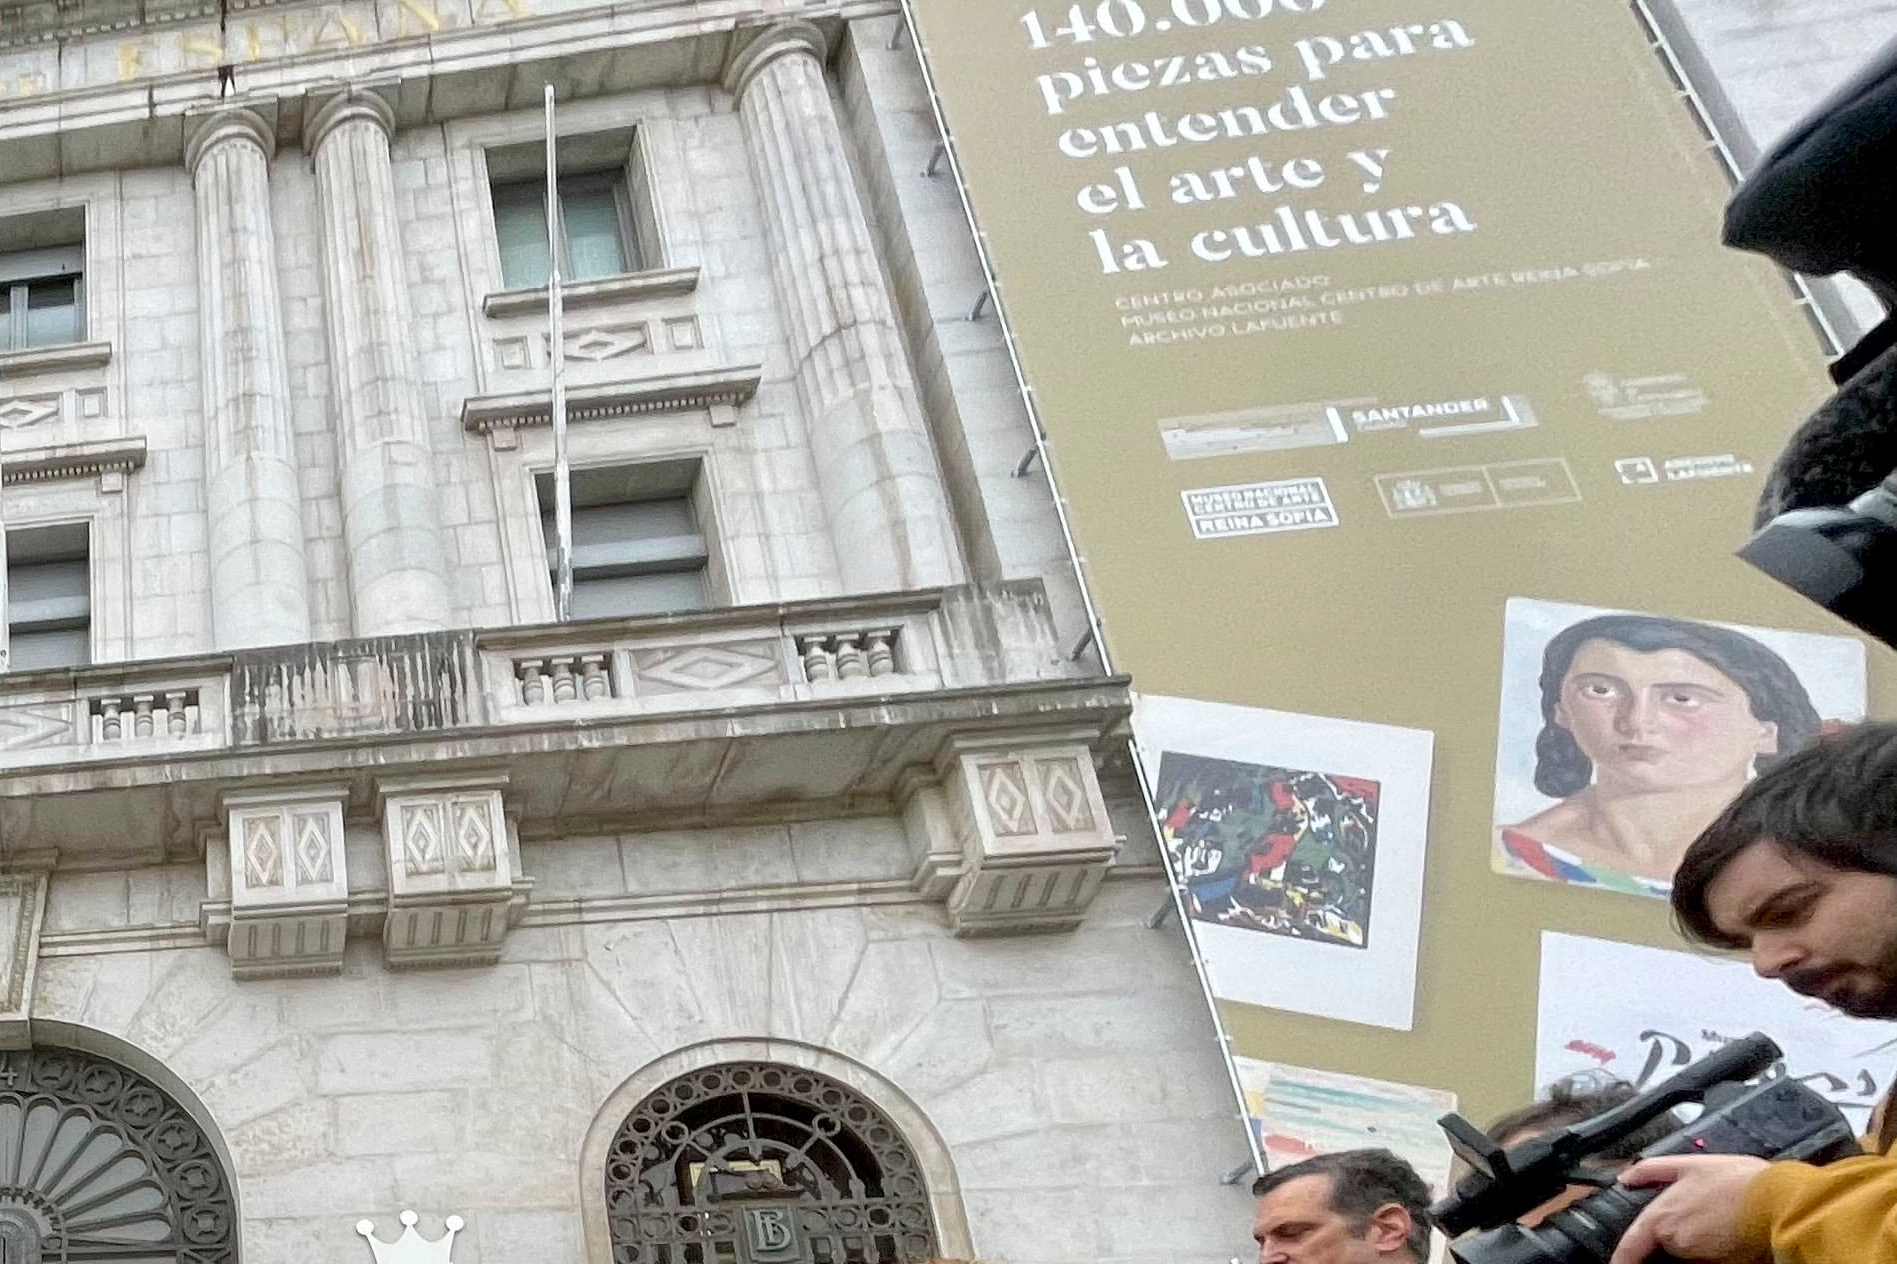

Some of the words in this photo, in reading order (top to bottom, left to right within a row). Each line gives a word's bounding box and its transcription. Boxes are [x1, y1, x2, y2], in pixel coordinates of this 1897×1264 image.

[1037, 44, 1273, 115] piezas
[1294, 19, 1476, 81] para
[1058, 84, 1396, 158] entender
[1077, 166, 1146, 214] el
[1168, 155, 1325, 205] arte
[1346, 149, 1391, 194] y
[1088, 228, 1168, 274] la
[1190, 201, 1478, 262] cultura
[1115, 289, 1203, 311] CENTRO
[1211, 275, 1330, 299] ASOCIADO
[1120, 307, 1195, 329] MUSEO
[1203, 295, 1314, 319] NACIONAL
[1320, 284, 1408, 306] CENTRO
[1129, 323, 1225, 346] ARCHIVO
[1231, 310, 1344, 335] LAFUENTE
[1352, 395, 1488, 423] SANTANDER
[1199, 515, 1264, 532] REINA
